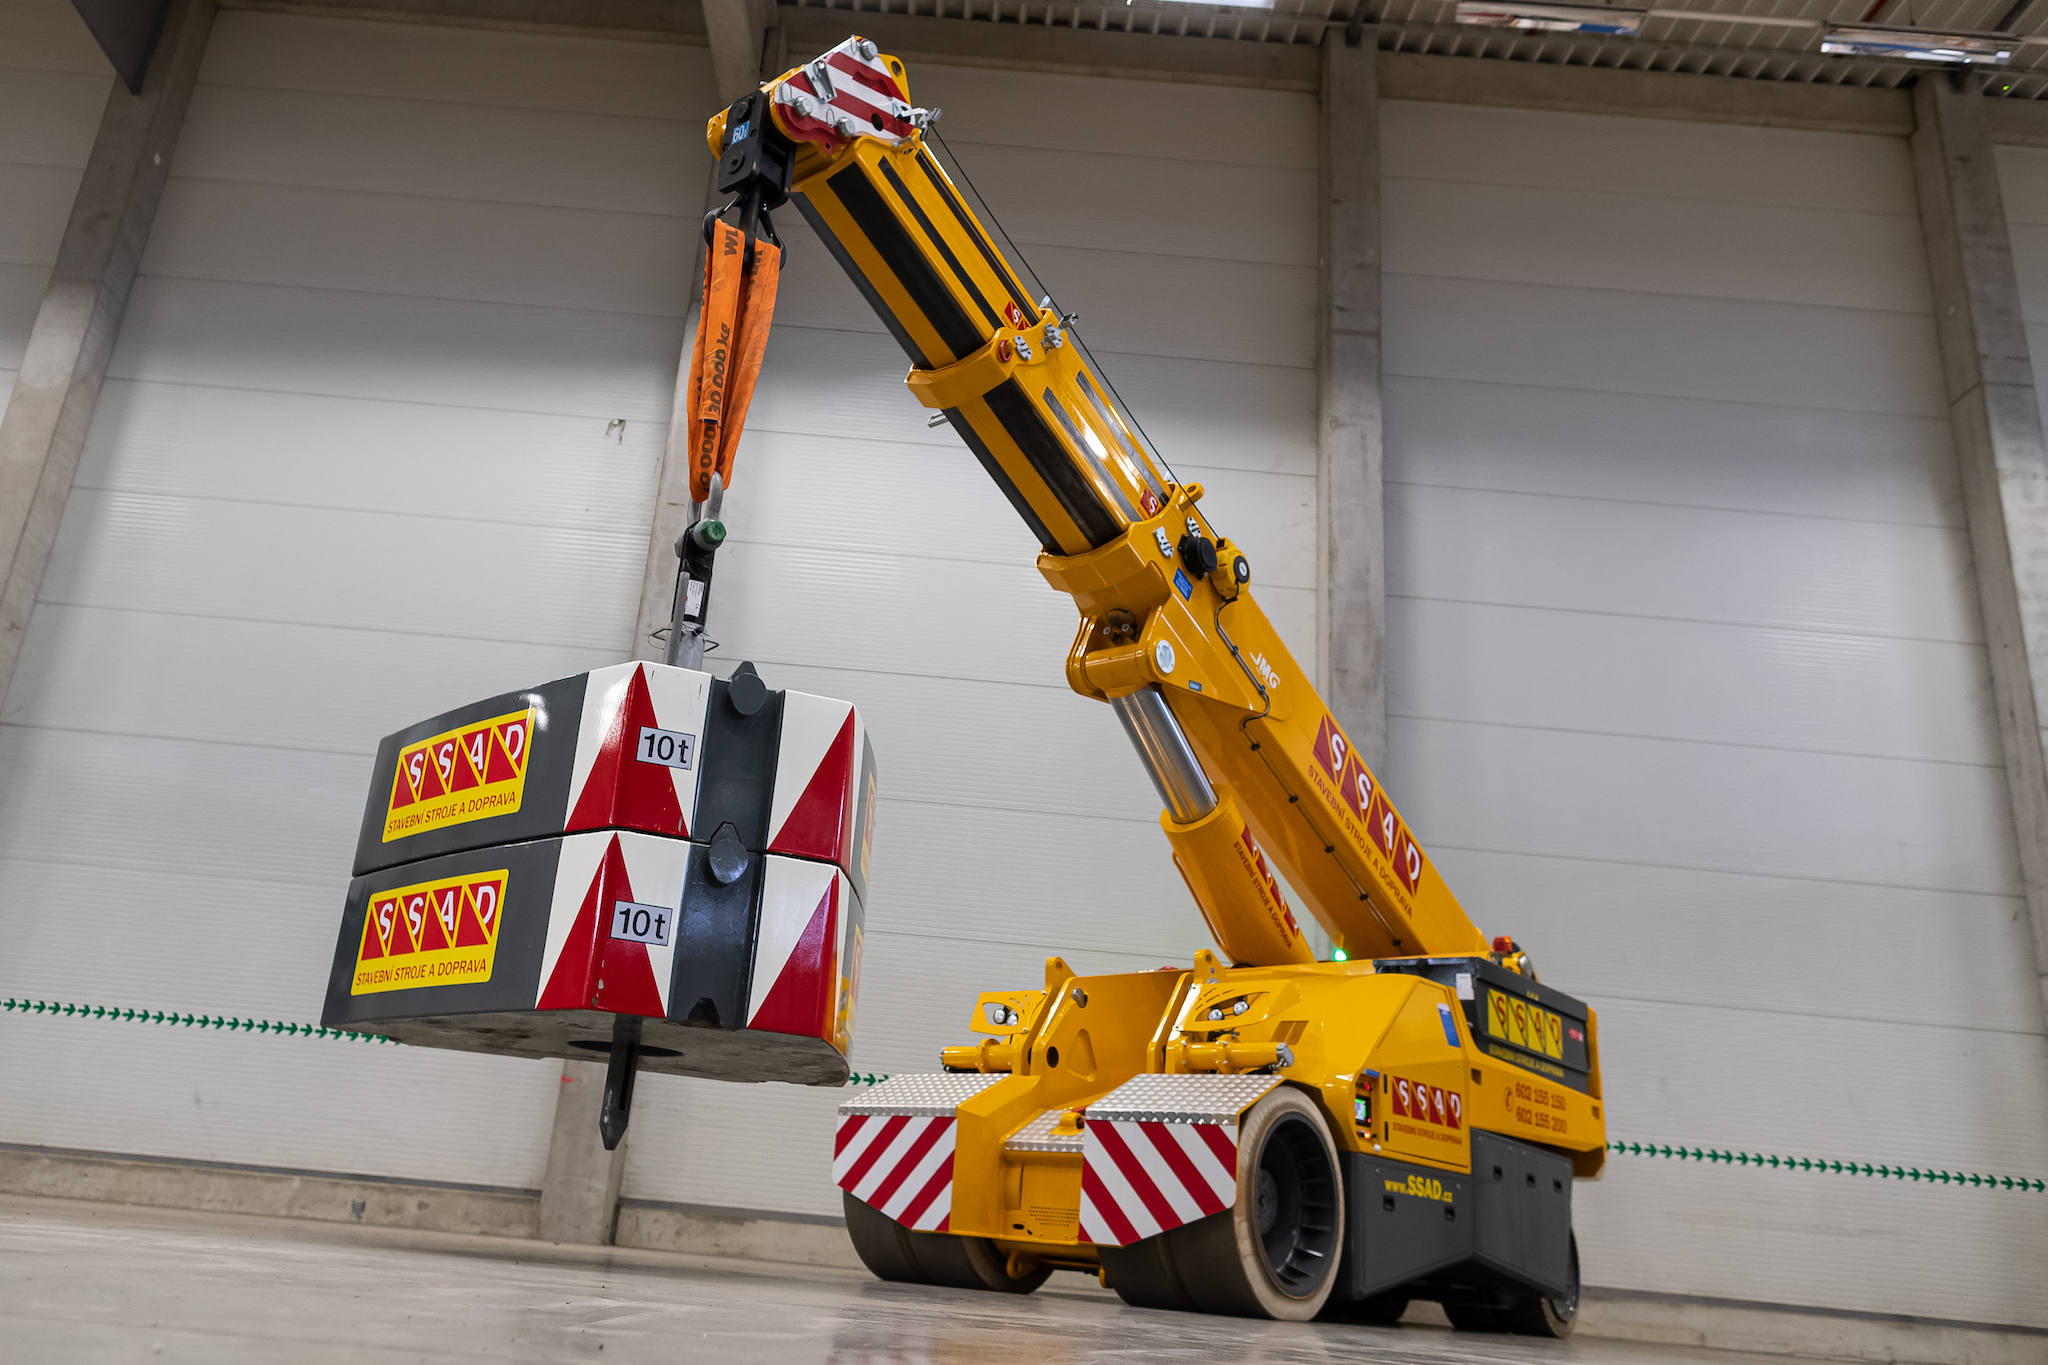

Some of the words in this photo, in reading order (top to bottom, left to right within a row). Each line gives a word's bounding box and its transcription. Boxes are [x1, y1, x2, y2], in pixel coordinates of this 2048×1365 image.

[712, 348, 726, 388] 000
[708, 390, 722, 415] 30
[1250, 652, 1281, 689] JMG
[410, 724, 524, 788] SSAD
[387, 808, 424, 834] STAVEBNÍ
[425, 802, 457, 823] STROJE
[458, 801, 466, 814] A
[467, 791, 516, 813] DOPRAVA
[1331, 733, 1420, 881] SSAD
[1308, 764, 1345, 821] STAVEBNÍ
[1345, 816, 1373, 861] STROJE
[1372, 857, 1379, 871] A
[1379, 865, 1413, 919] DOPRAVA
[379, 885, 496, 940] SSAD
[1233, 840, 1256, 879] STAVEBNÍ
[1252, 877, 1269, 907] STROJE
[1267, 906, 1274, 914] A
[1271, 912, 1293, 949] DOPRAVA
[356, 964, 394, 987] STAVEBNÍ
[394, 964, 427, 981] STROJE
[428, 964, 435, 977] A
[437, 958, 487, 976] DOPRAVA
[1496, 996, 1562, 1045] SSAD
[1399, 1080, 1461, 1118] SSAD
[1384, 1174, 1453, 1203] www.SSAD.cz
